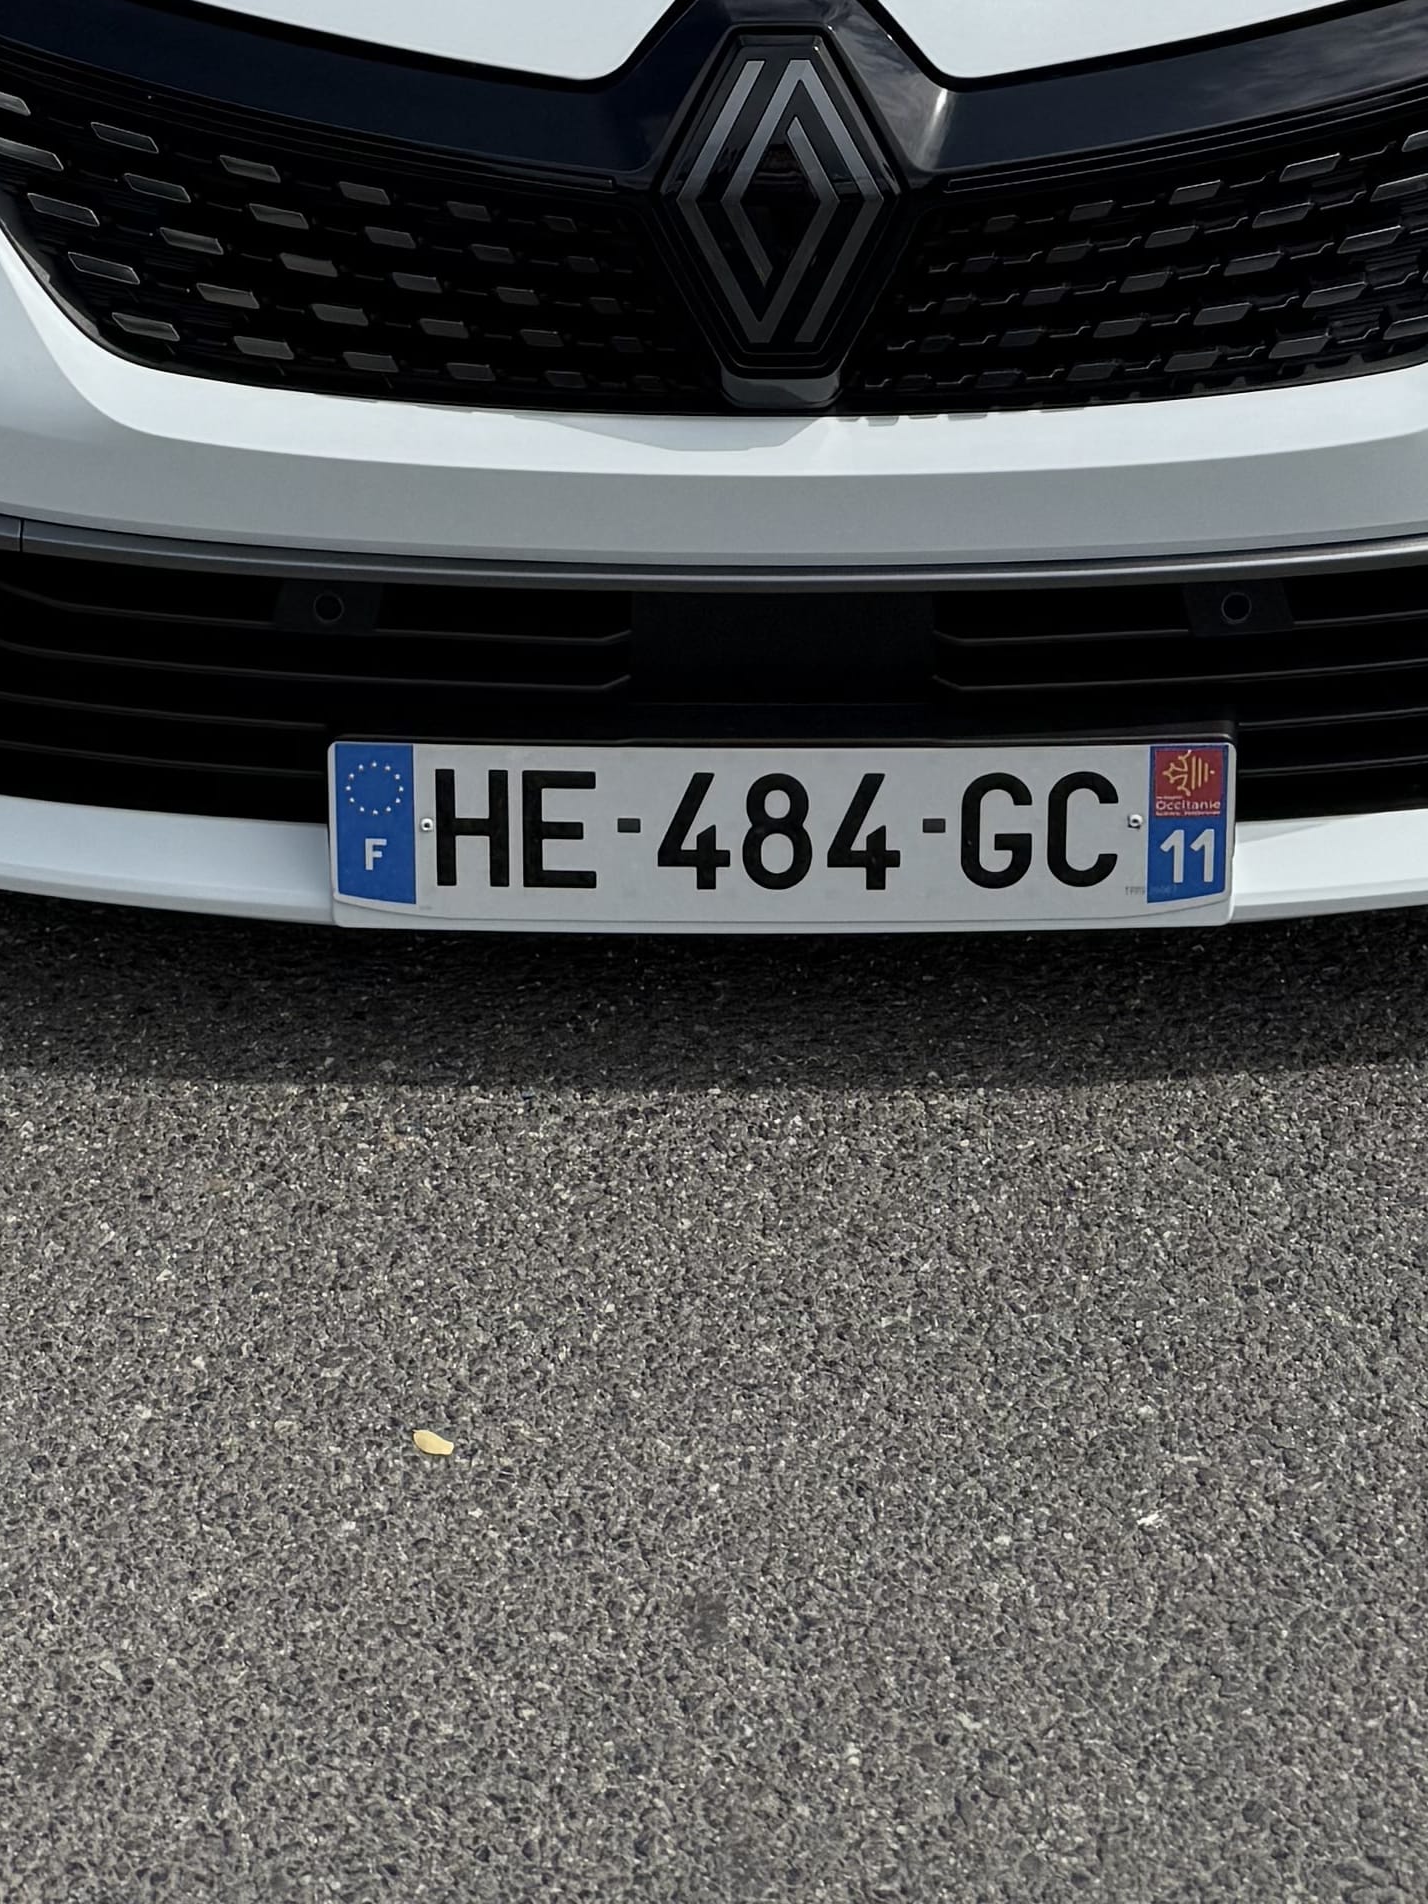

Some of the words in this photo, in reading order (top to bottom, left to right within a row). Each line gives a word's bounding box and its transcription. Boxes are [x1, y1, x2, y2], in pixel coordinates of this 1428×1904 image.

[1155, 799, 1221, 811] Occitanie
[435, 769, 1118, 892] HE-484-GC
[365, 838, 388, 871] F
[1159, 828, 1216, 884] 11
